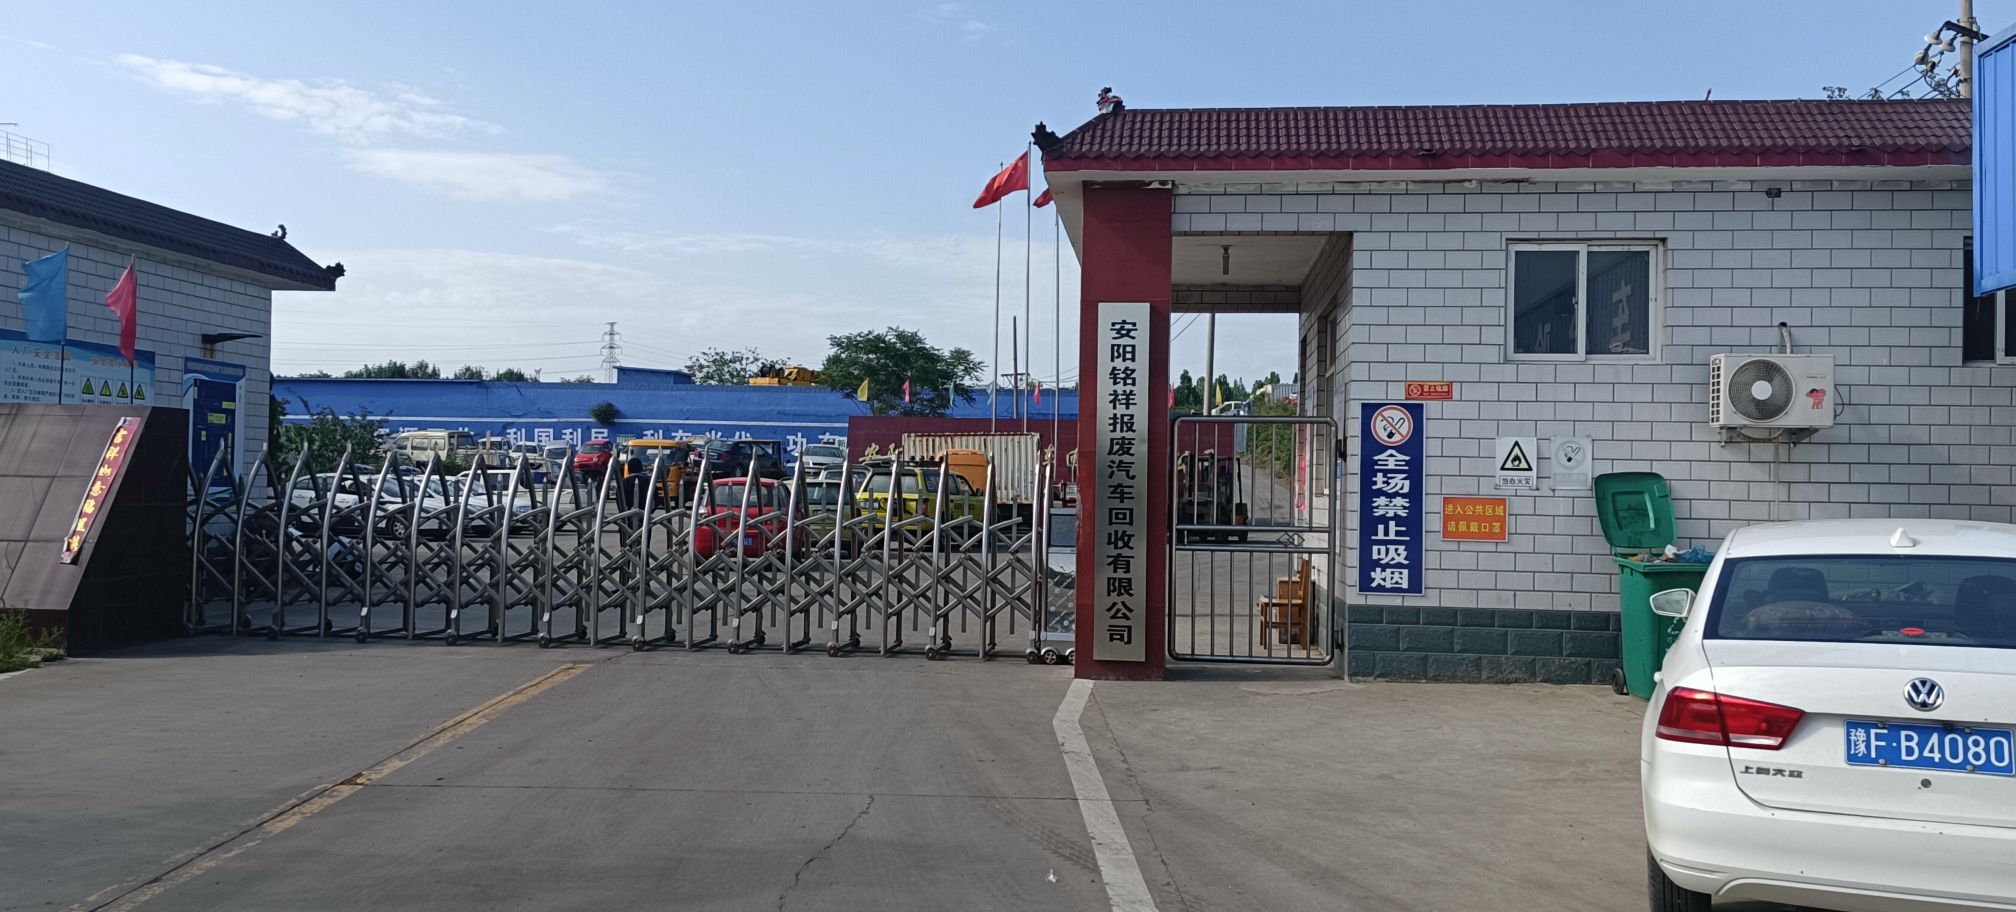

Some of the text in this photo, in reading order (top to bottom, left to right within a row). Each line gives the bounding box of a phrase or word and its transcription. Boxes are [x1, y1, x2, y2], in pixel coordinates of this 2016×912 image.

[1105, 319, 1138, 645] 安阳铭祥报废汽车回收有限公司
[1501, 477, 1531, 486] 当心火灾
[1370, 449, 1411, 589] 全场禁止吸烟
[1444, 503, 1505, 516] 进入公共区域
[1447, 521, 1501, 533] 请佩戴口罩
[1848, 727, 2010, 768] 豫F·B4080
